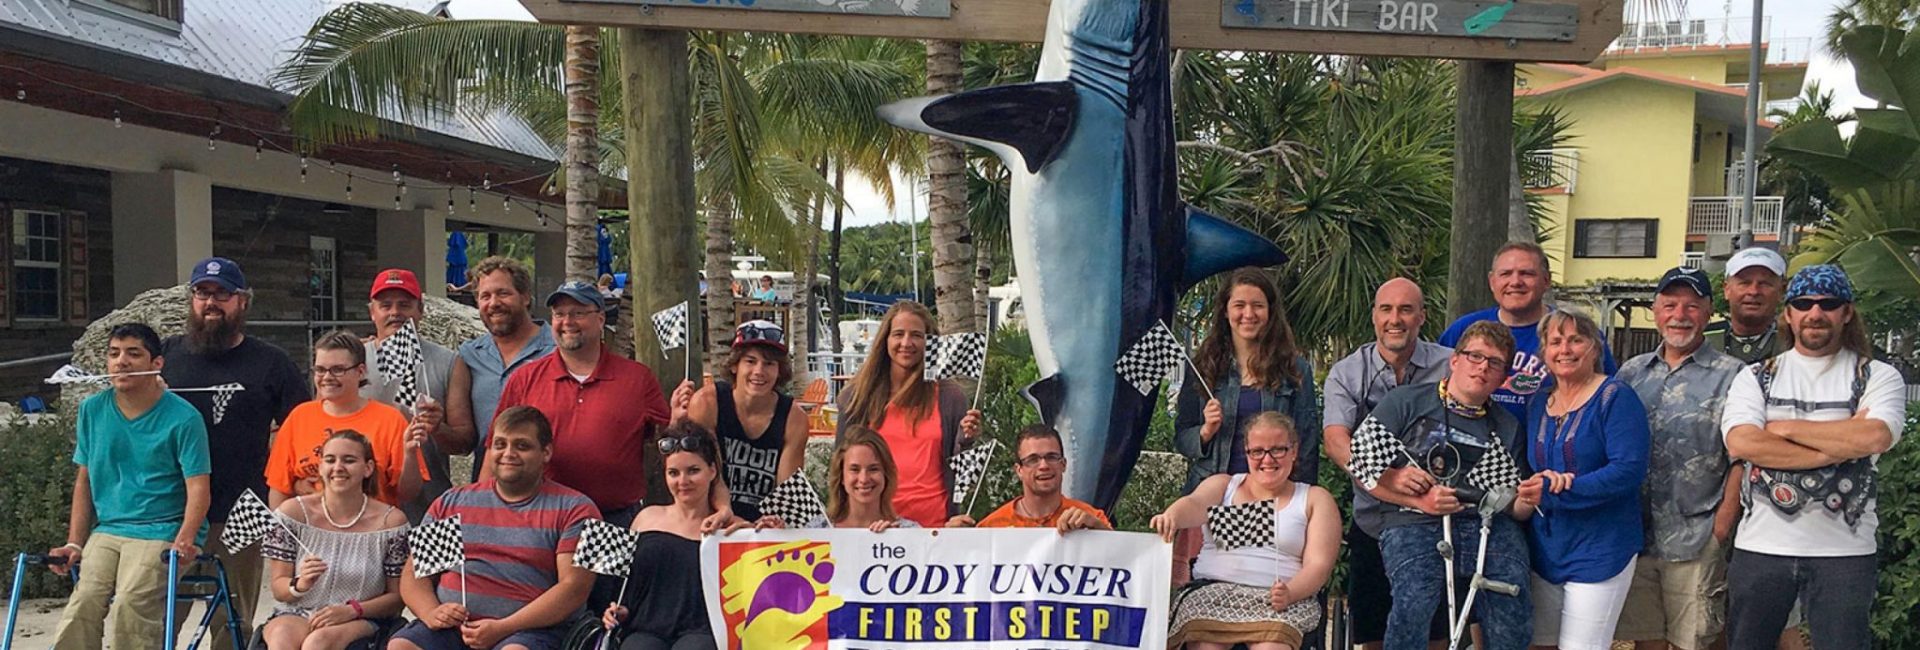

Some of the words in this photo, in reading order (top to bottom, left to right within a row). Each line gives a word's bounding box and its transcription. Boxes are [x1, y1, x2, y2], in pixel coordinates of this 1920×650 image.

[1379, 1, 1438, 32] BAR
[872, 542, 906, 559] the
[859, 563, 979, 596] CODY
[989, 563, 1132, 599] UNSER
[859, 607, 979, 640] FIRST
[1008, 605, 1110, 641] STEP
